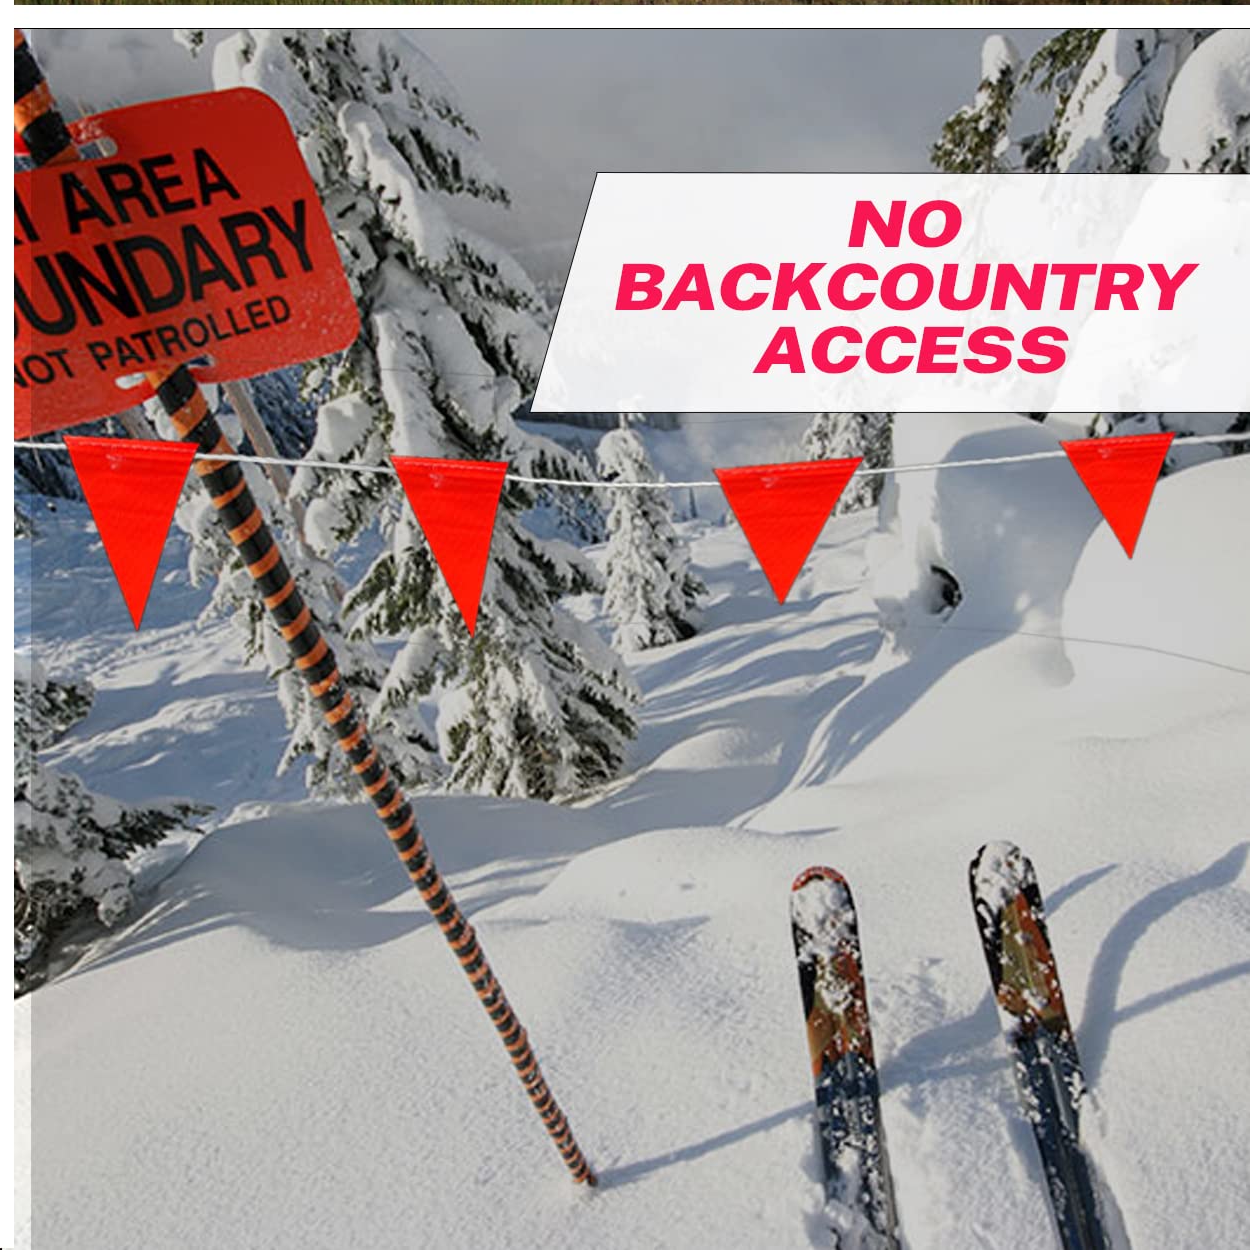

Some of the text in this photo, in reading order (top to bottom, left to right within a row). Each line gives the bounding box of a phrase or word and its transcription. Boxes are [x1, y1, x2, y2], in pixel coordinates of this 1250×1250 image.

[60, 147, 241, 234] AREA
[14, 199, 314, 339] UNDARY
[87, 295, 291, 371] PATROLLED
